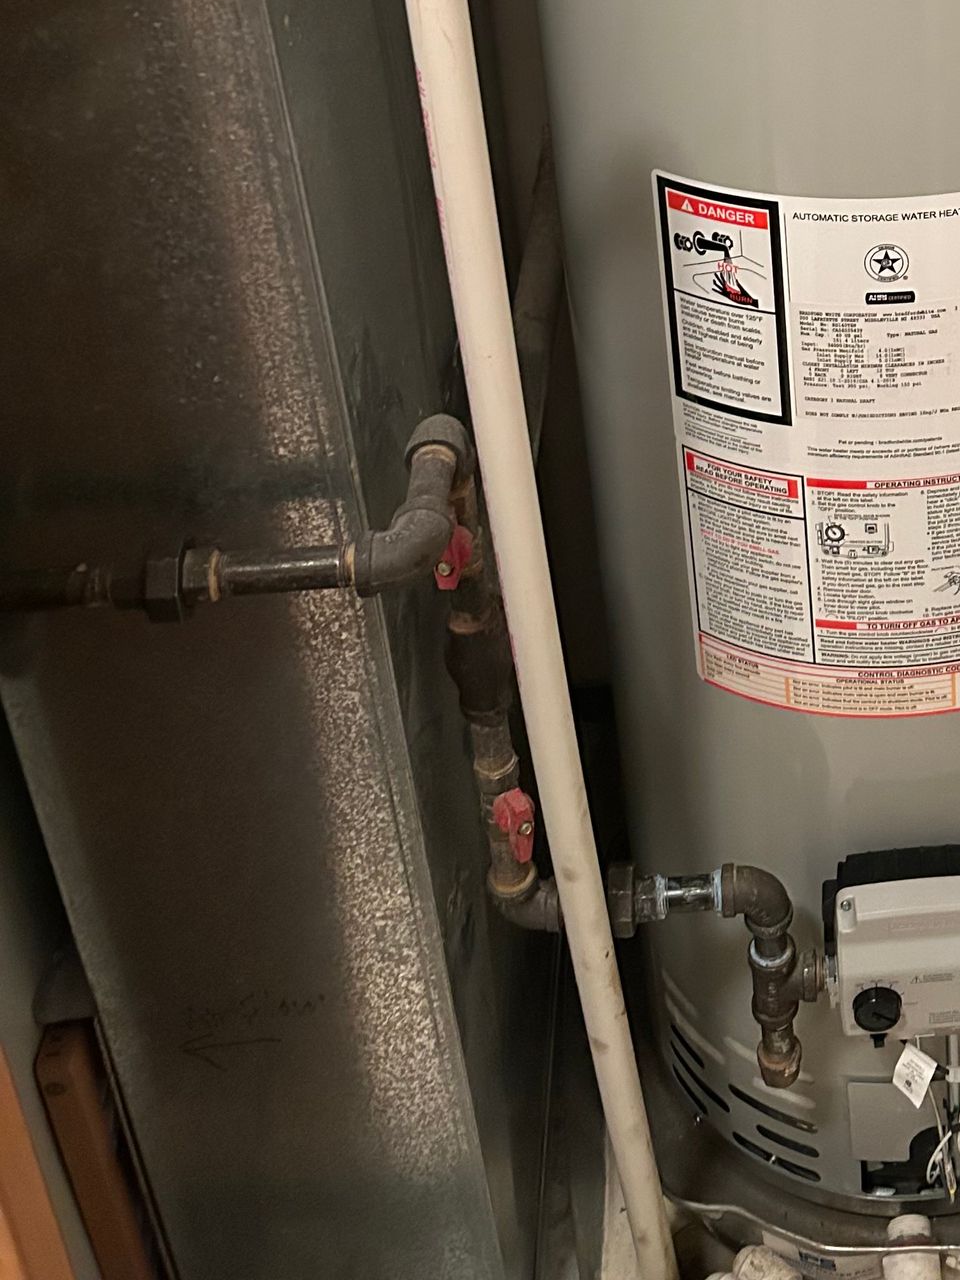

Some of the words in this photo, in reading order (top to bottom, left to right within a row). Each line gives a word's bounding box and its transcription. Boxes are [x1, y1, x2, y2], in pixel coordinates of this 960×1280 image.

[699, 204, 754, 224] DANGER
[792, 212, 849, 222] AUTOMATIC
[851, 214, 899, 222] STORAGE
[901, 211, 936, 220] WATER
[717, 261, 738, 274] HOT
[696, 465, 713, 476] READ
[715, 472, 742, 482] BEFORE
[745, 481, 787, 493] OPERATING
[708, 463, 721, 472] FOR
[723, 468, 742, 478] YOUR
[744, 474, 772, 485] SAFETY
[874, 481, 920, 489] OPERATING
[896, 667, 945, 678] DIAGNOSTIC
